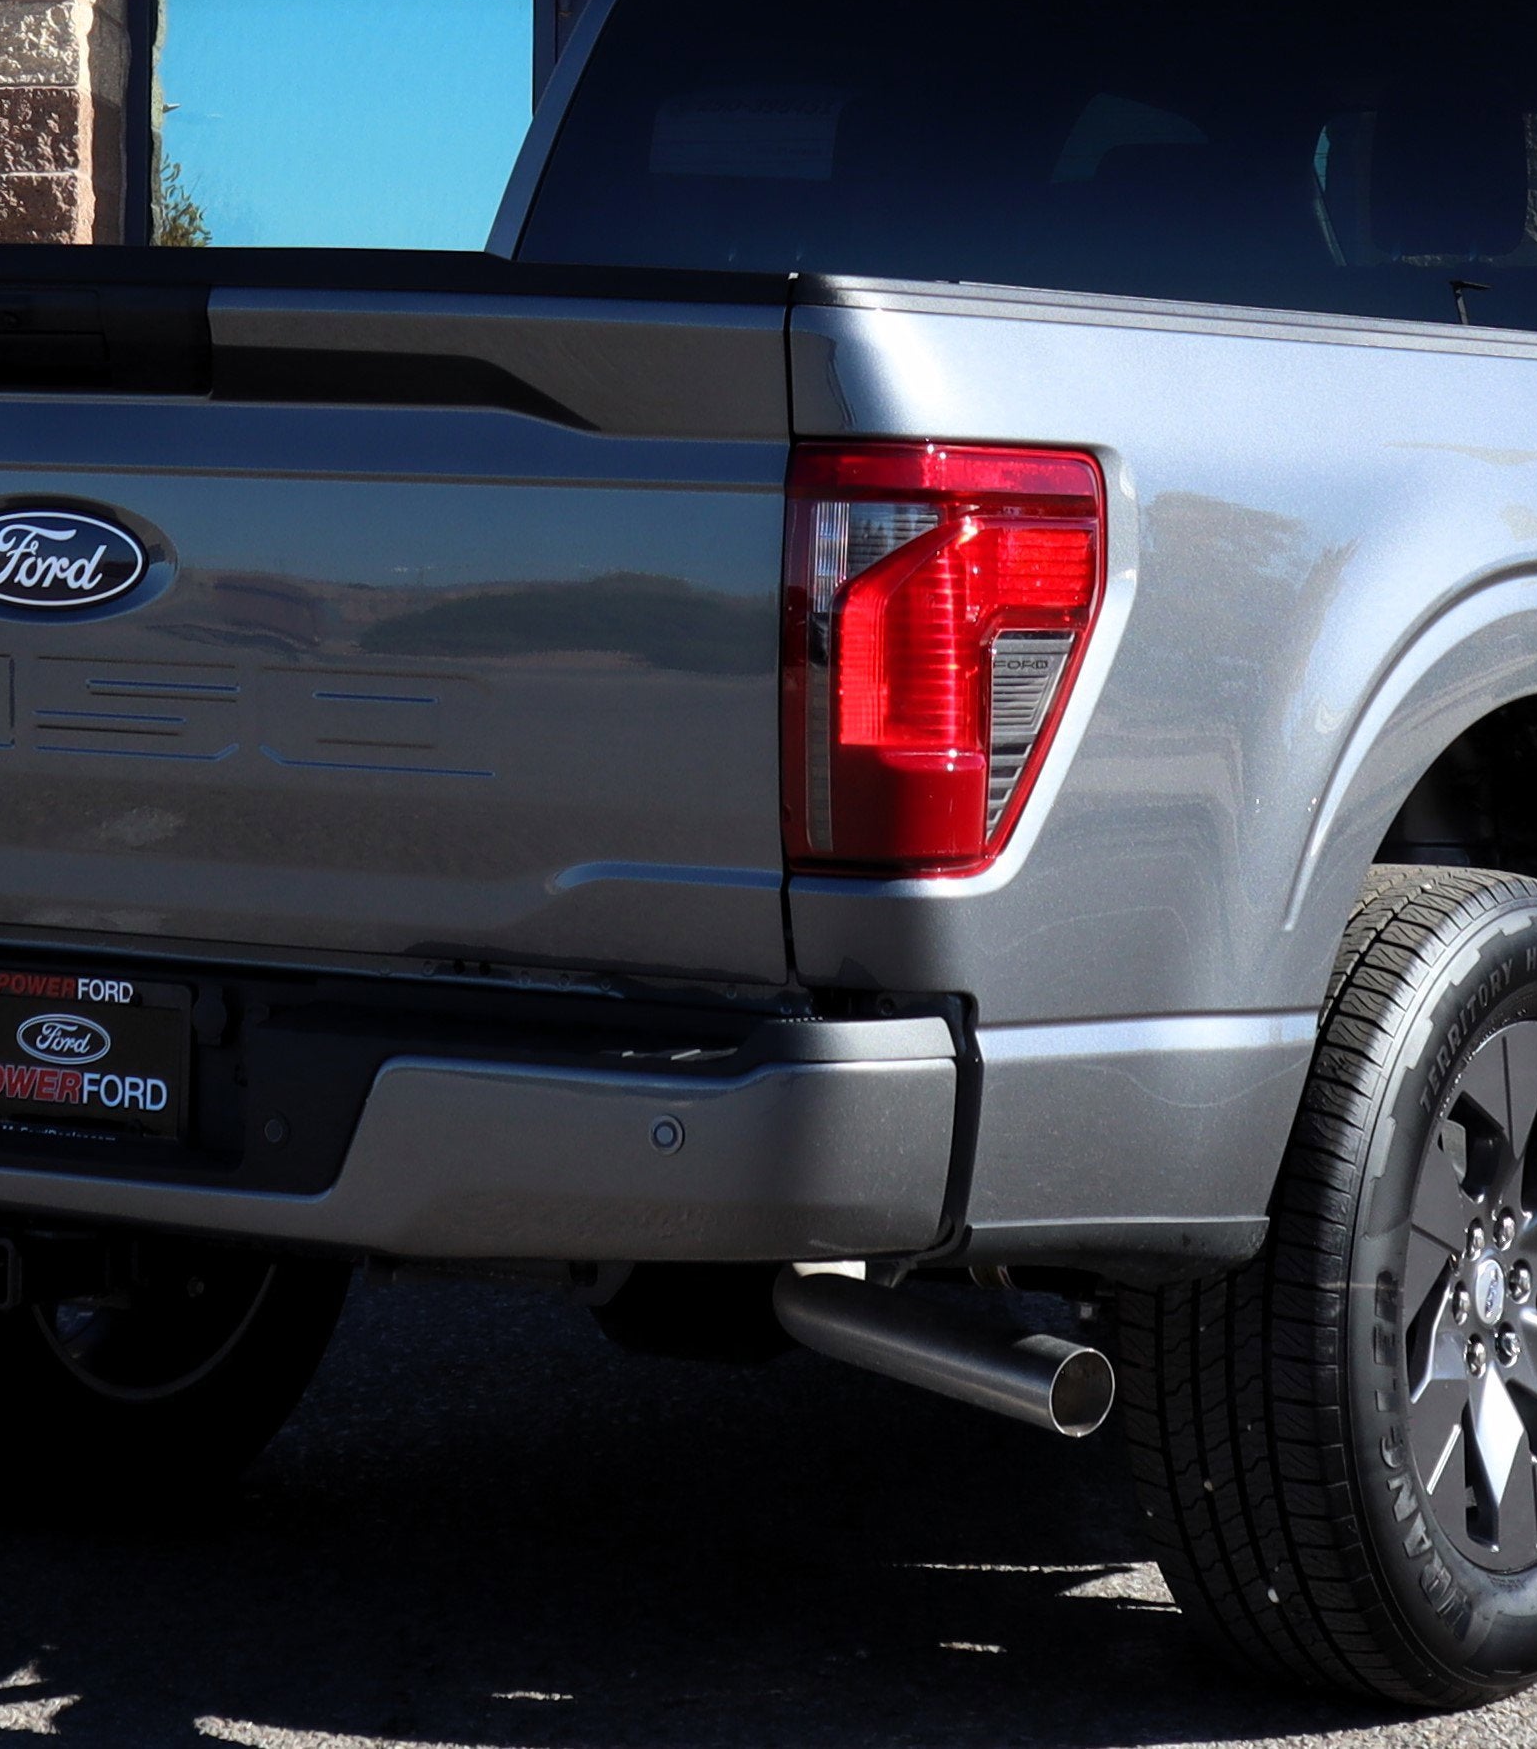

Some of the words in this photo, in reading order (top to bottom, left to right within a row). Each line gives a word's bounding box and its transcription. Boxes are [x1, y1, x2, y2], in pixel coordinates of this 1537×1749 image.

[35, 1022, 93, 1054] Ford
[1418, 957, 1514, 1113] TERRITORY
[1373, 1270, 1471, 1644] WRANGLER
